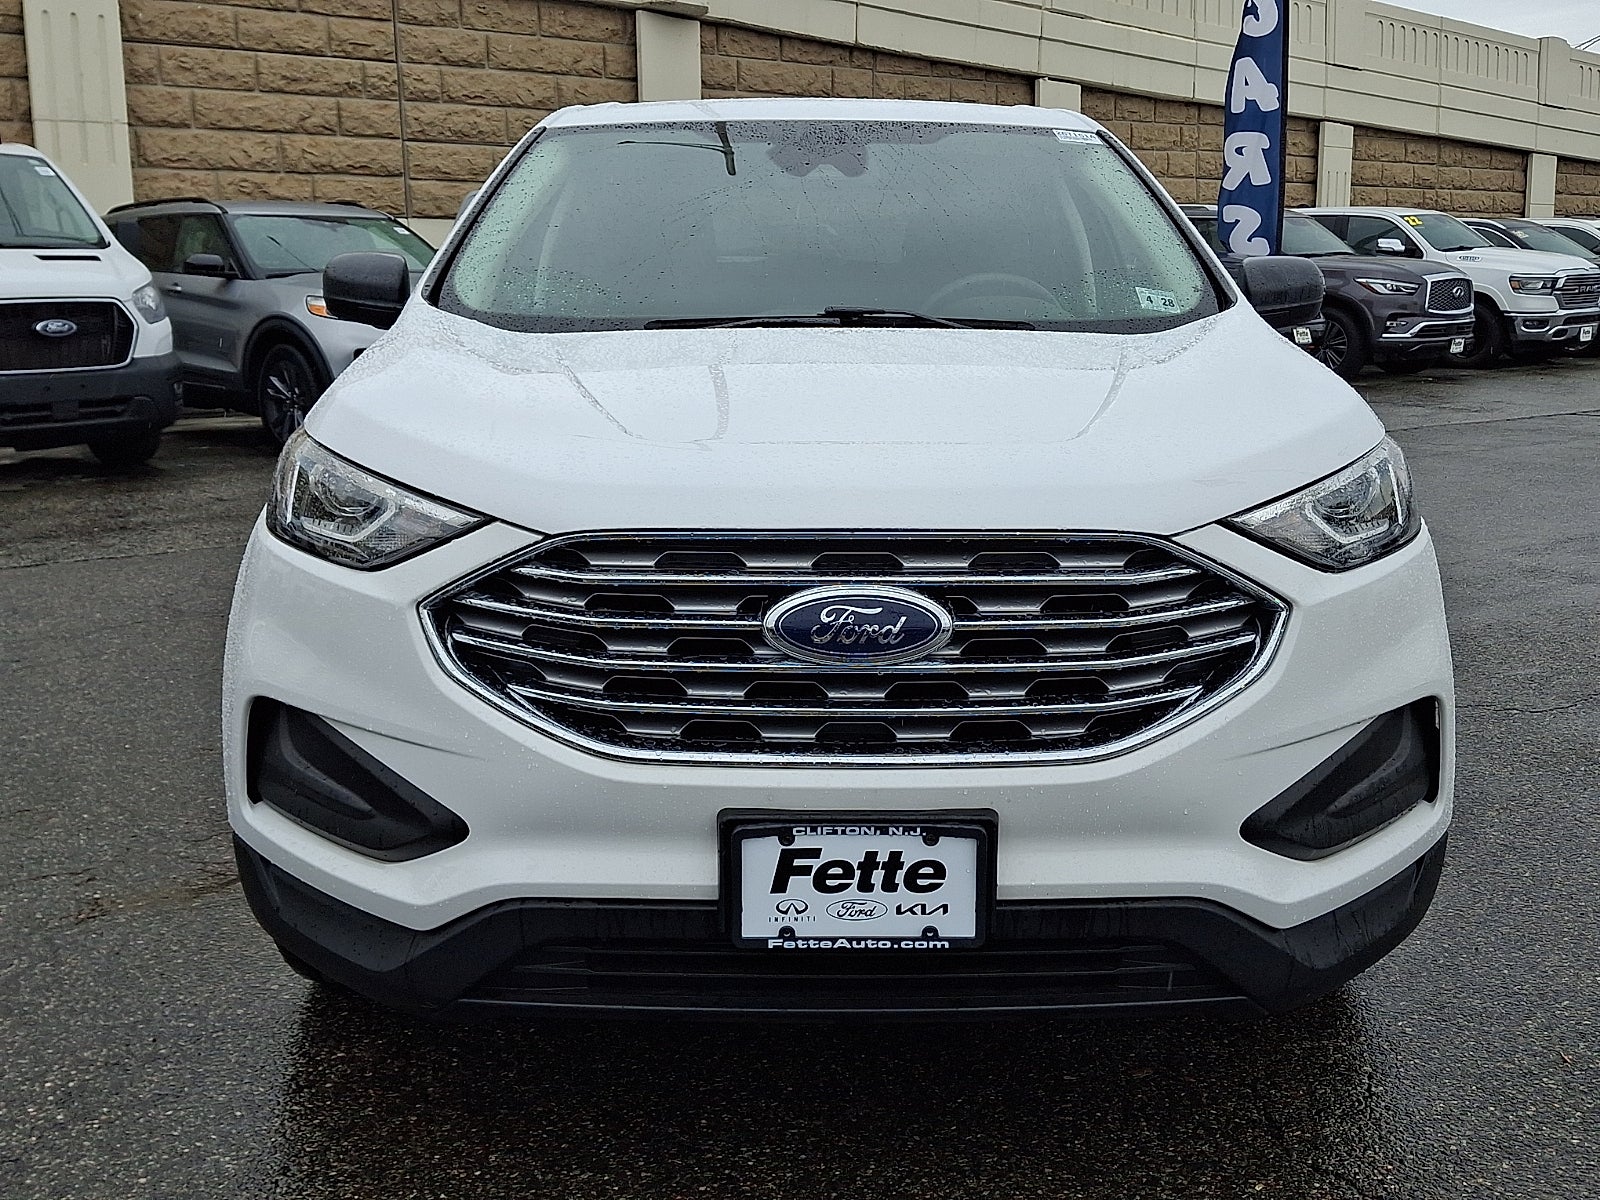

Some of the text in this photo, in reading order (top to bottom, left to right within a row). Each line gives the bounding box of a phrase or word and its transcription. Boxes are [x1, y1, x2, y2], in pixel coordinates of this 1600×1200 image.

[1403, 216, 1423, 226] 22
[1146, 295, 1175, 307] 4 28
[810, 605, 908, 645] Ford
[792, 826, 927, 837] CLIFTON, N.J.
[769, 847, 948, 895] Fette
[836, 901, 878, 918] Ford
[895, 903, 949, 916] KIA
[767, 938, 950, 949] FetteAuto.com
